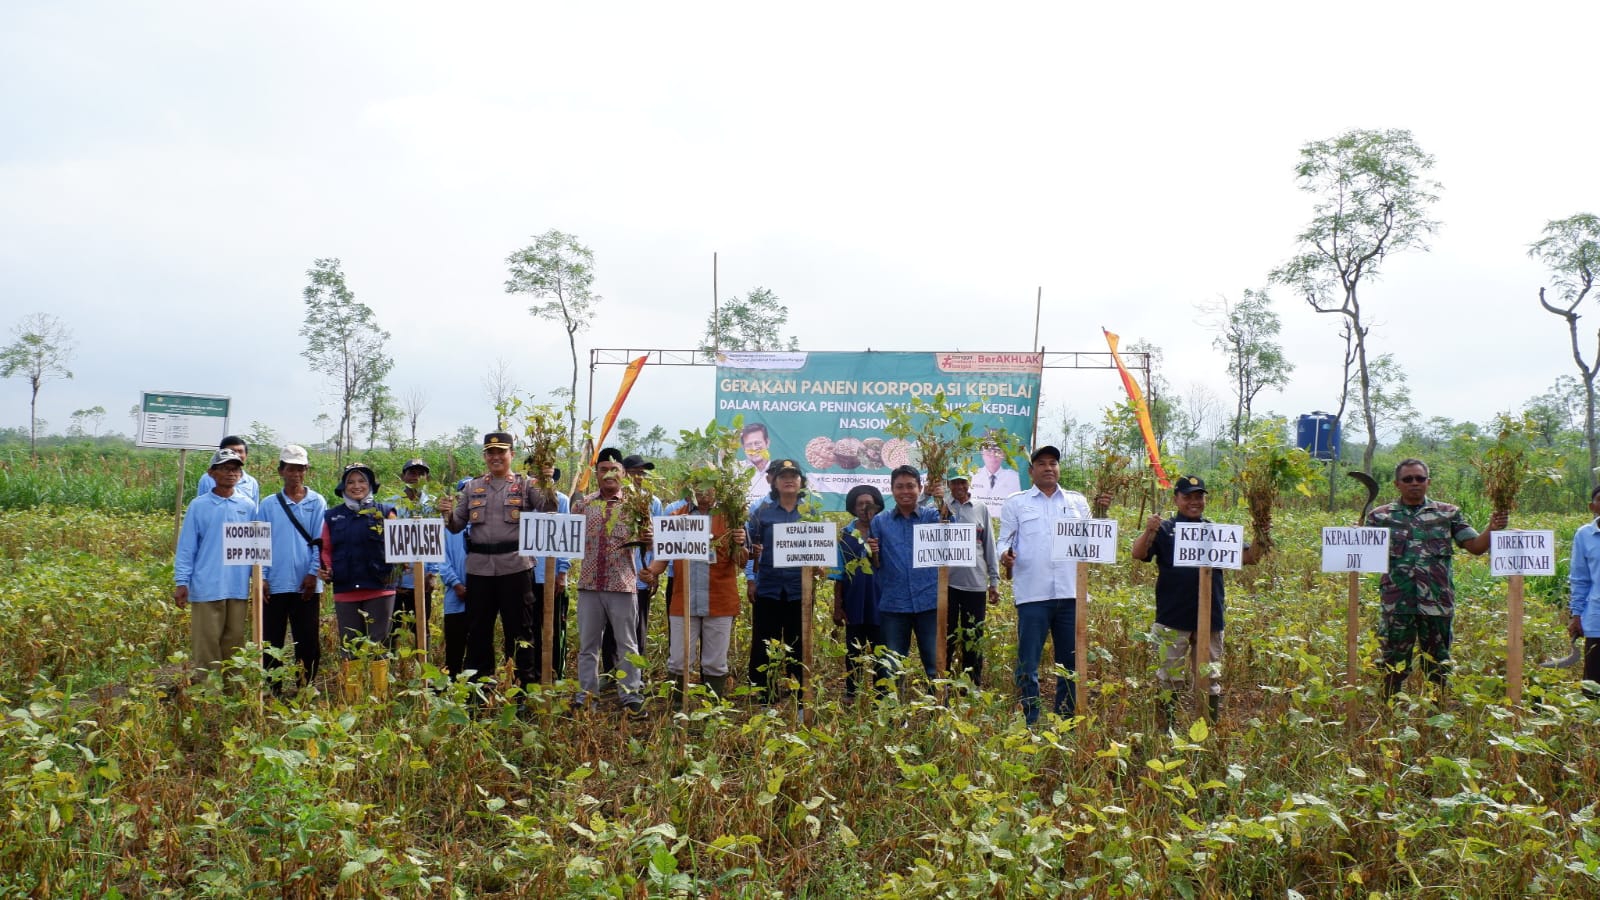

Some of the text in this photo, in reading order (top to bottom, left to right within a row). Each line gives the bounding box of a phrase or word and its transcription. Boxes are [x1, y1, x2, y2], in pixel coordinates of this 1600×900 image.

[977, 354, 1040, 364] BerAKHLAK
[720, 379, 1032, 399] GERAKAN PANEN KORPORASI KEDELAI
[720, 399, 761, 411] DALAM
[763, 401, 817, 413] RANGKA
[982, 403, 1031, 417] KEDELAI
[660, 519, 704, 532] PANEWU
[786, 525, 825, 535] KEPALA DINAS
[1057, 522, 1112, 538] DIREKTUR
[388, 524, 443, 556] KAPOLSEK
[522, 518, 583, 553] LURAH
[919, 528, 971, 542] WAKIL BUPATI
[1180, 527, 1238, 544] KEPALA
[1325, 529, 1387, 546] KEPALA DPKP
[1497, 534, 1545, 550] DIREKTUR
[656, 541, 707, 555] PONJONG
[775, 539, 834, 549] PERTANIAN & PANGAN
[1065, 543, 1101, 559] AKABI
[226, 547, 243, 560] BPP
[786, 553, 826, 562] GUNUNGKIDUL
[917, 547, 973, 563] GUNUNGKIDUL
[1178, 547, 1238, 563] BBP OPT
[1346, 553, 1363, 569] DIY
